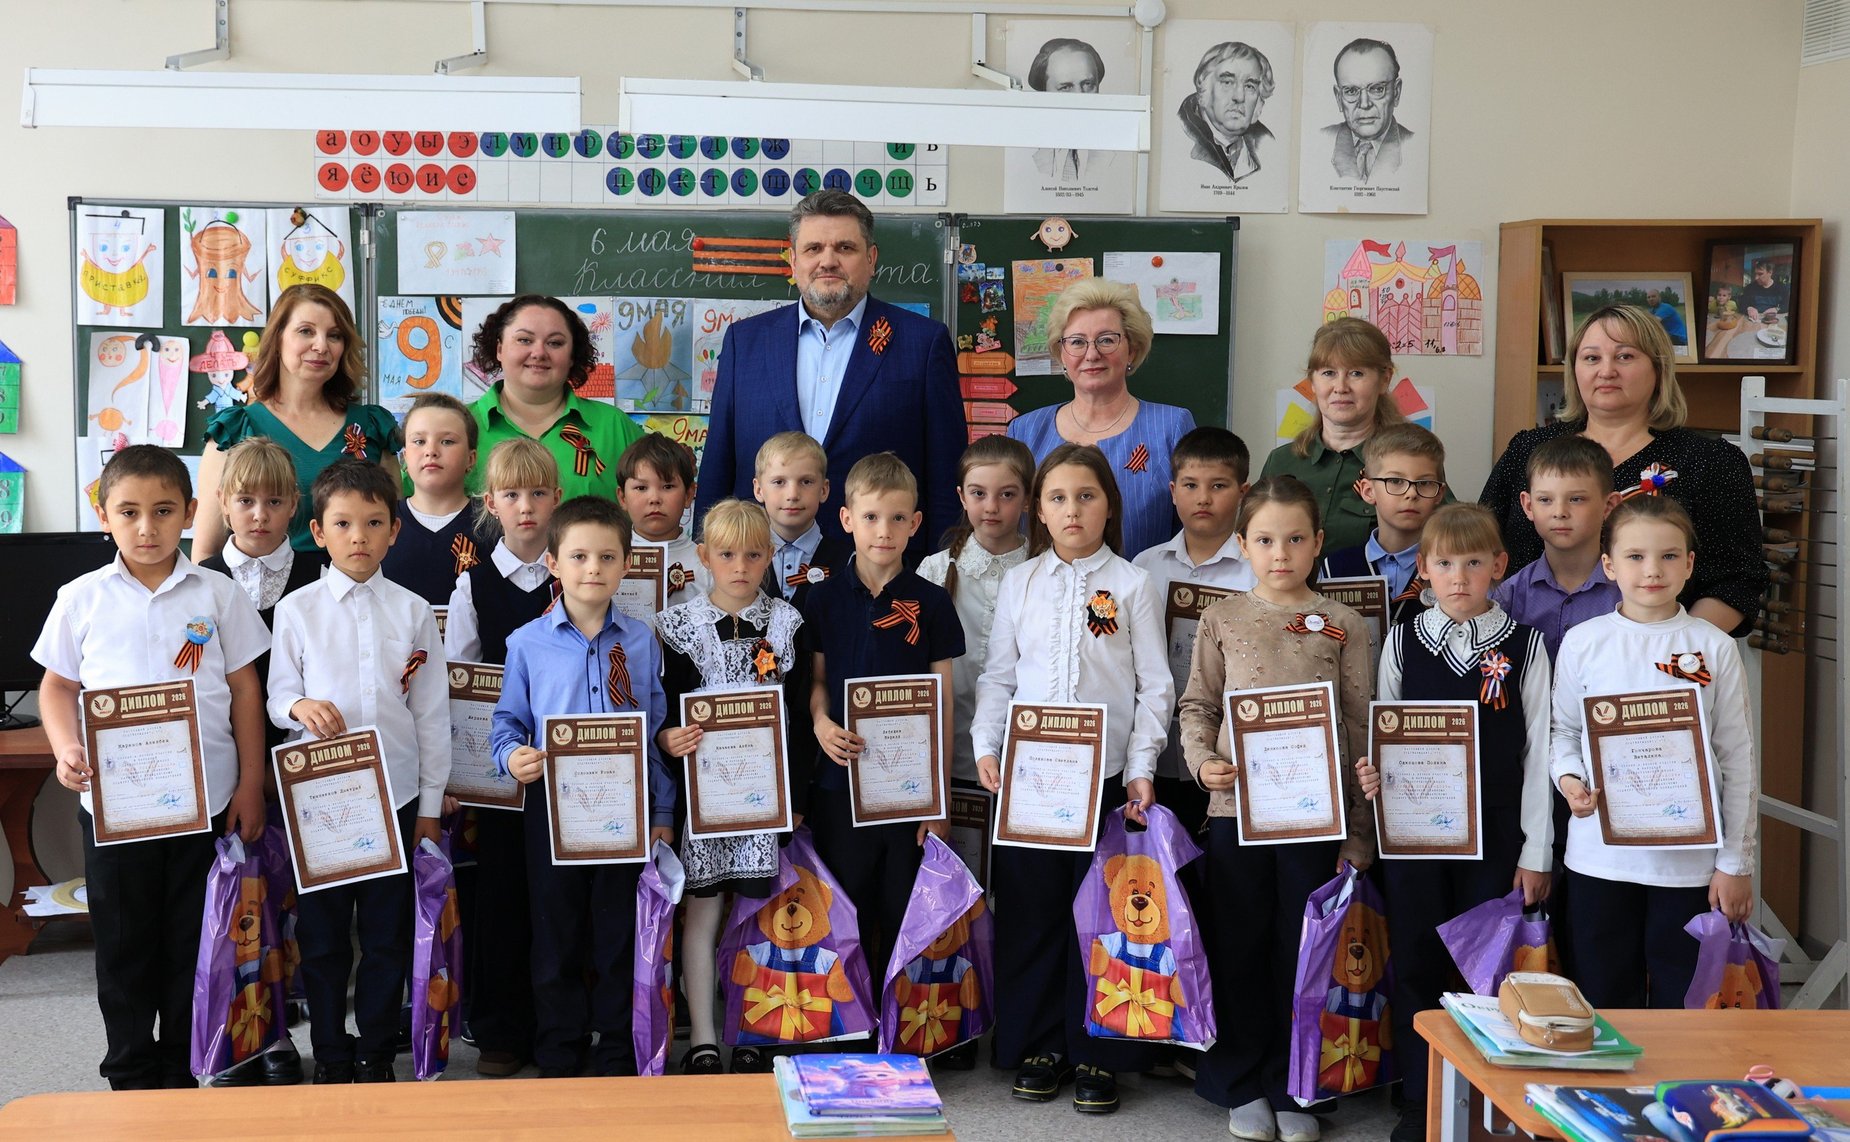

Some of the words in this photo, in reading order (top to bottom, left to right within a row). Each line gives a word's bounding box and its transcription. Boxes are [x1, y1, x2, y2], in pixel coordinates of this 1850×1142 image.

[591, 227, 607, 255] 6
[617, 228, 696, 254] мая
[284, 267, 334, 283] СУФФИКС
[396, 315, 443, 390] 9
[383, 373, 402, 385] МАЯ
[472, 674, 502, 688] ДИПЛО
[120, 692, 166, 713] ДИПЛОМ
[875, 688, 913, 705] ДИПЛОМ
[716, 701, 755, 718] ДИПЛОМ
[1264, 699, 1305, 717] ДИПЛОМ
[1621, 701, 1669, 720] ДИПЛОМ
[1040, 715, 1079, 730] ДИПЛОМ
[1403, 715, 1446, 730] ДИПЛОМ
[577, 727, 617, 742] ДИПЛОМ
[310, 743, 352, 766] ДИПЛОМ
